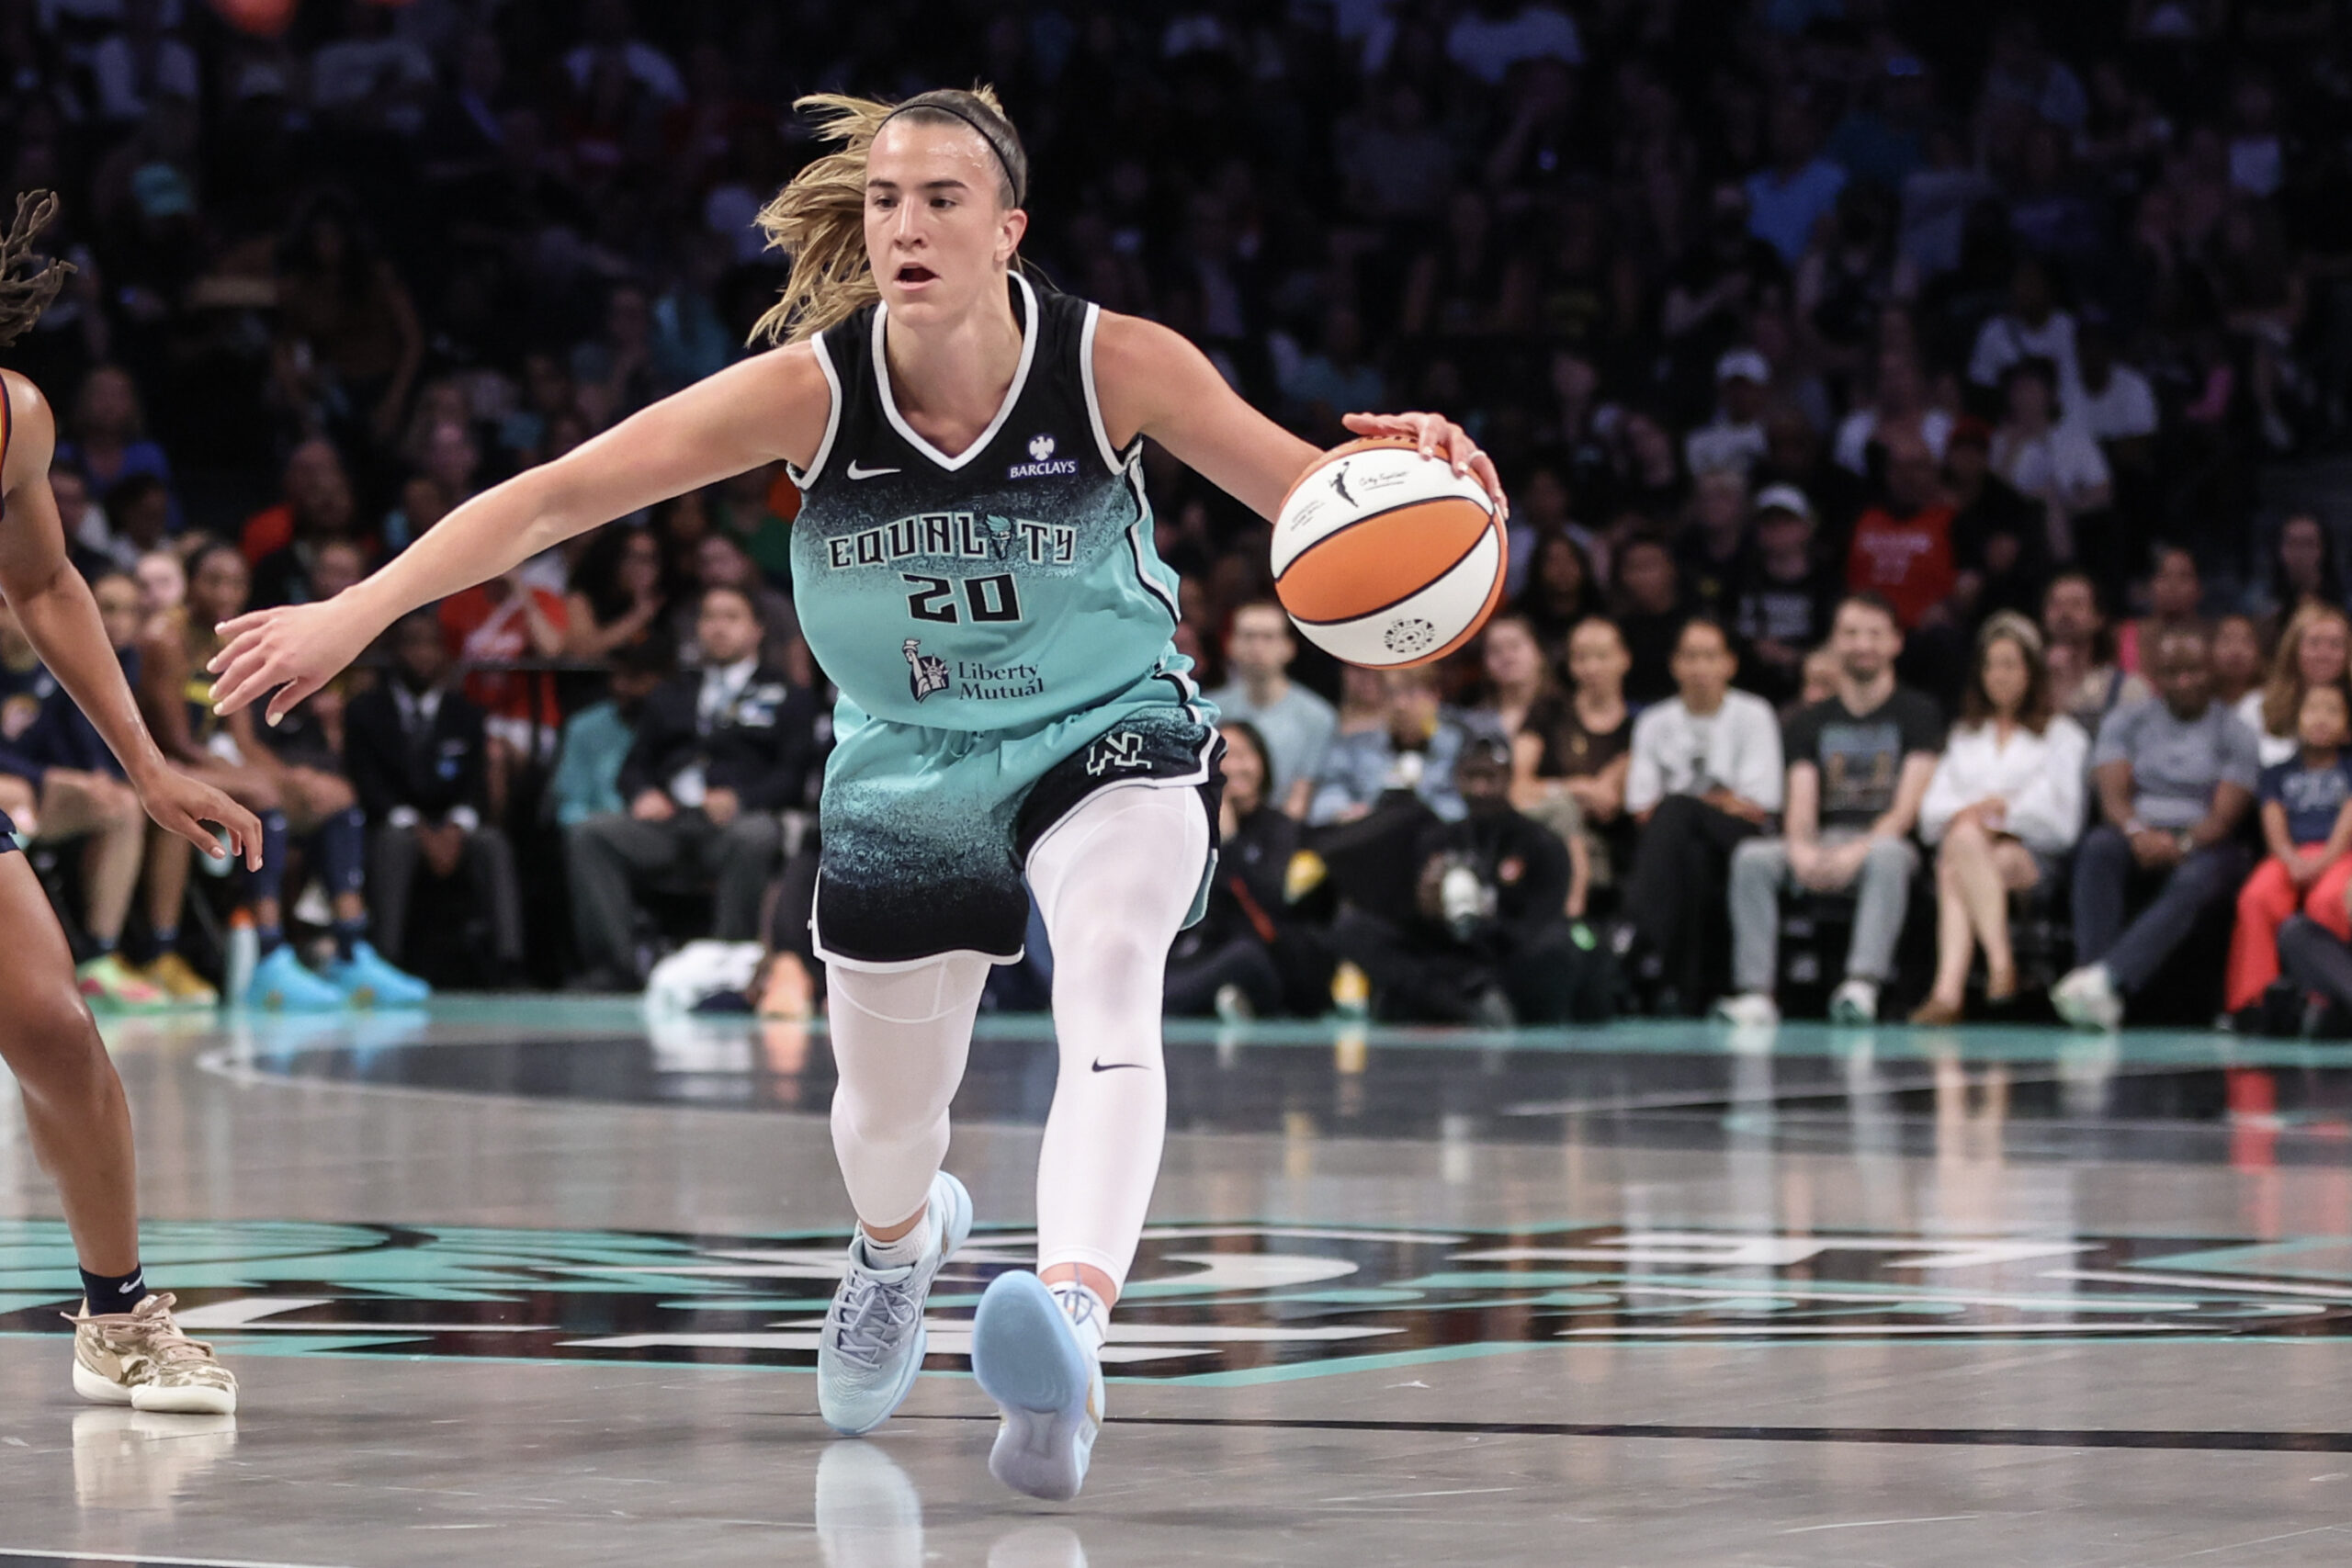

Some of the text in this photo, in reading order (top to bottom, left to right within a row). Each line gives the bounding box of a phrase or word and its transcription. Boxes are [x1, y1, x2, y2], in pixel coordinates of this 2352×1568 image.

[1010, 460, 1077, 479] BARCLAYS
[899, 572, 1023, 625] 20
[958, 660, 1039, 685] Liberty
[959, 677, 1045, 701] Mutual
